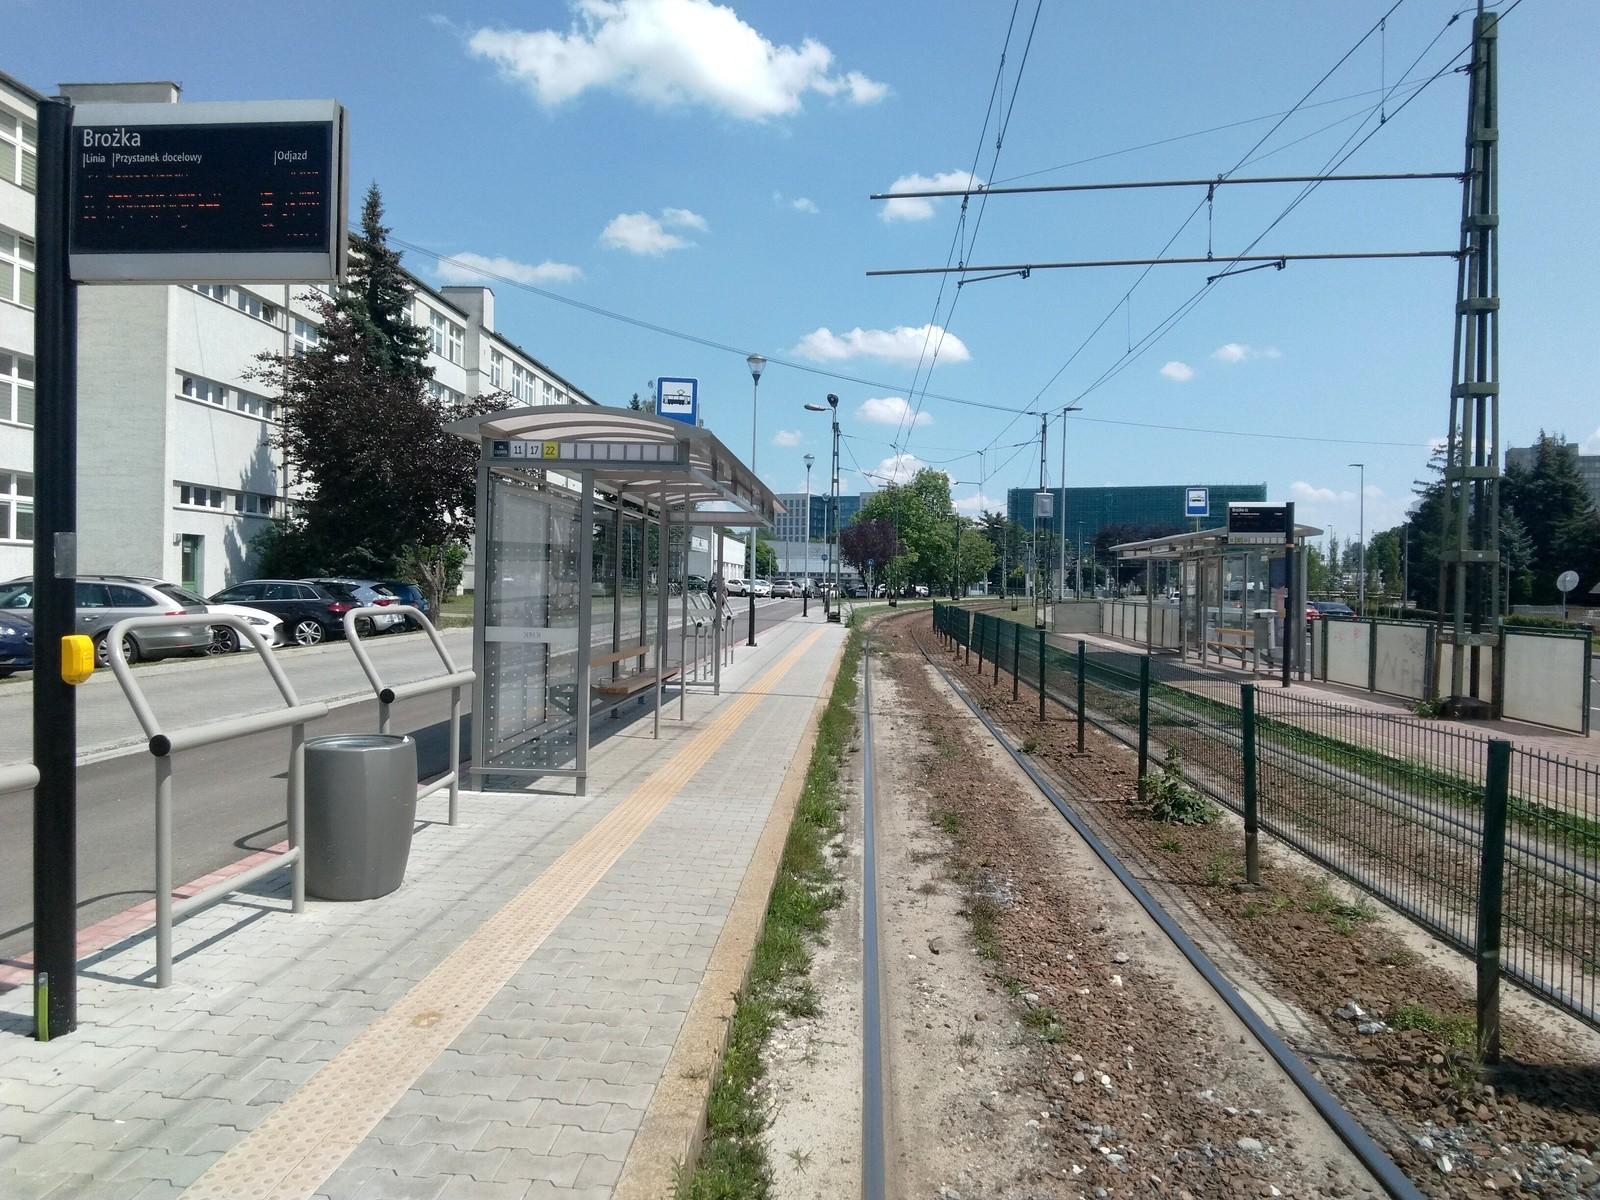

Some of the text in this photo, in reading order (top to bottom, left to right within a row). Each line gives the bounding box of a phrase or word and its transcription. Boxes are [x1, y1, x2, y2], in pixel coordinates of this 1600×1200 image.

[83, 128, 141, 147] Brożka
[86, 153, 106, 163] Linia
[115, 152, 202, 165] Przystanek docelowy
[277, 150, 308, 163] Odjazd
[514, 445, 522, 455] 11
[530, 445, 539, 455] 17
[545, 446, 555, 455] 22
